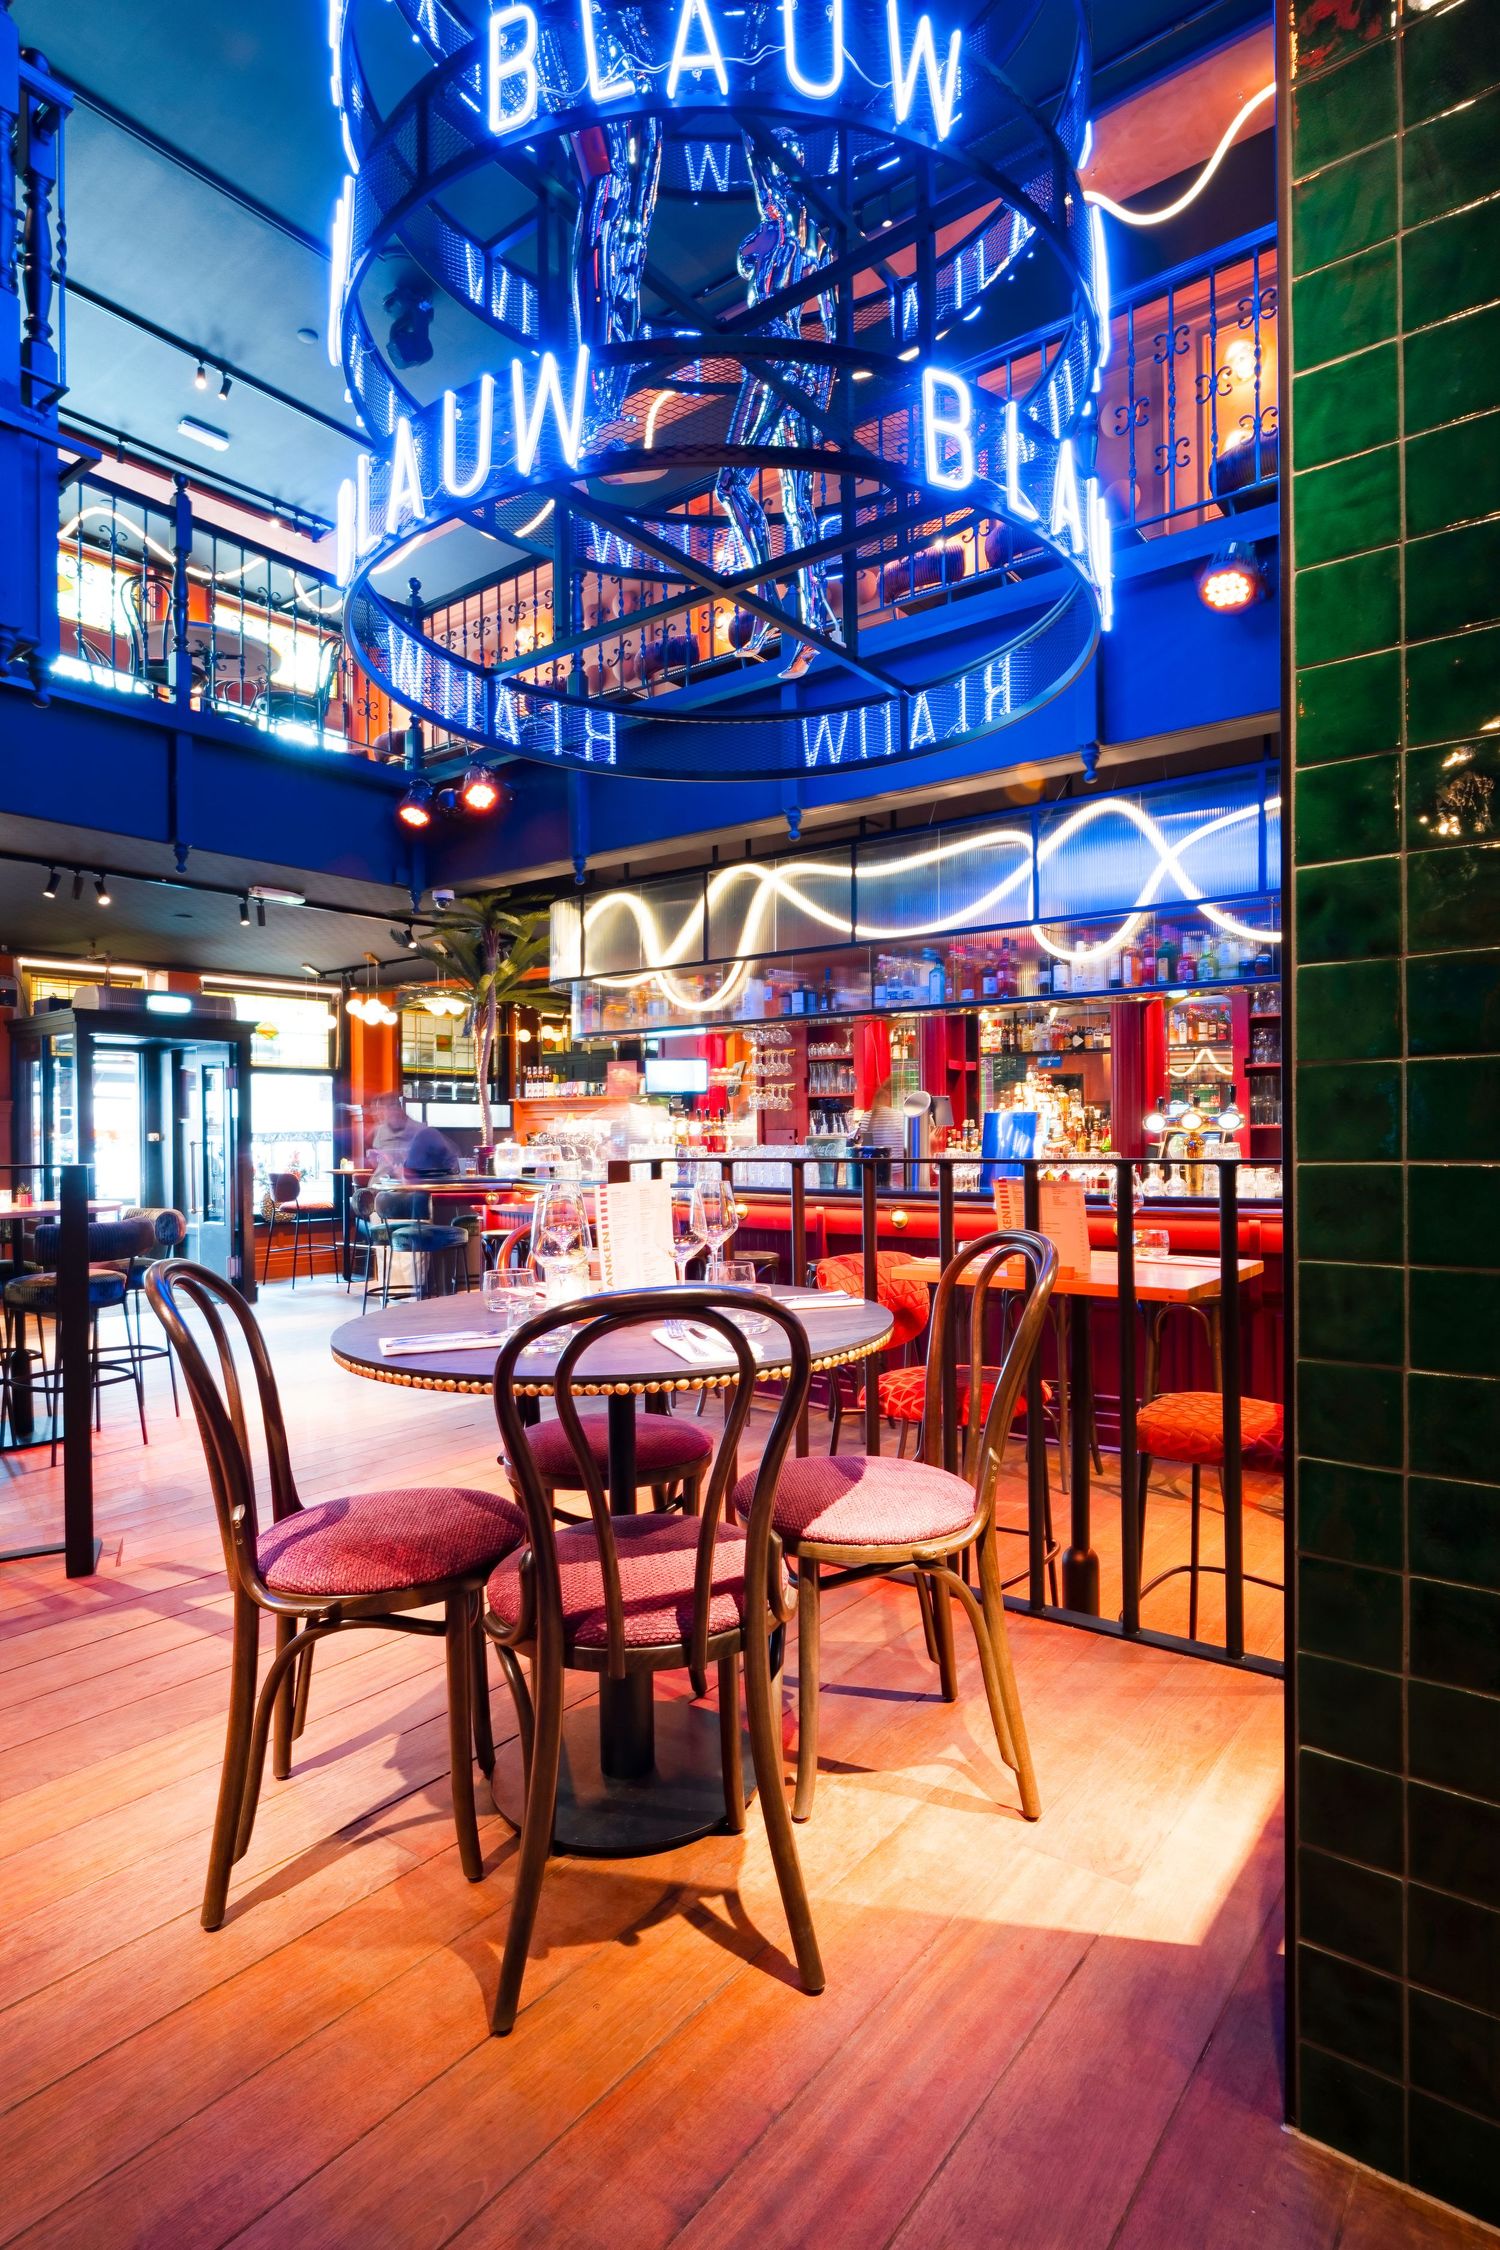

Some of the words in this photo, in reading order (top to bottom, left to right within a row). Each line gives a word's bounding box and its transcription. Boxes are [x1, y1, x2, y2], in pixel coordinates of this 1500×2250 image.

[488, 0, 962, 141] BLAUW
[336, 345, 590, 587] LAUW
[923, 366, 1113, 632] BLA
[602, 1231, 613, 1287] ANKEN
